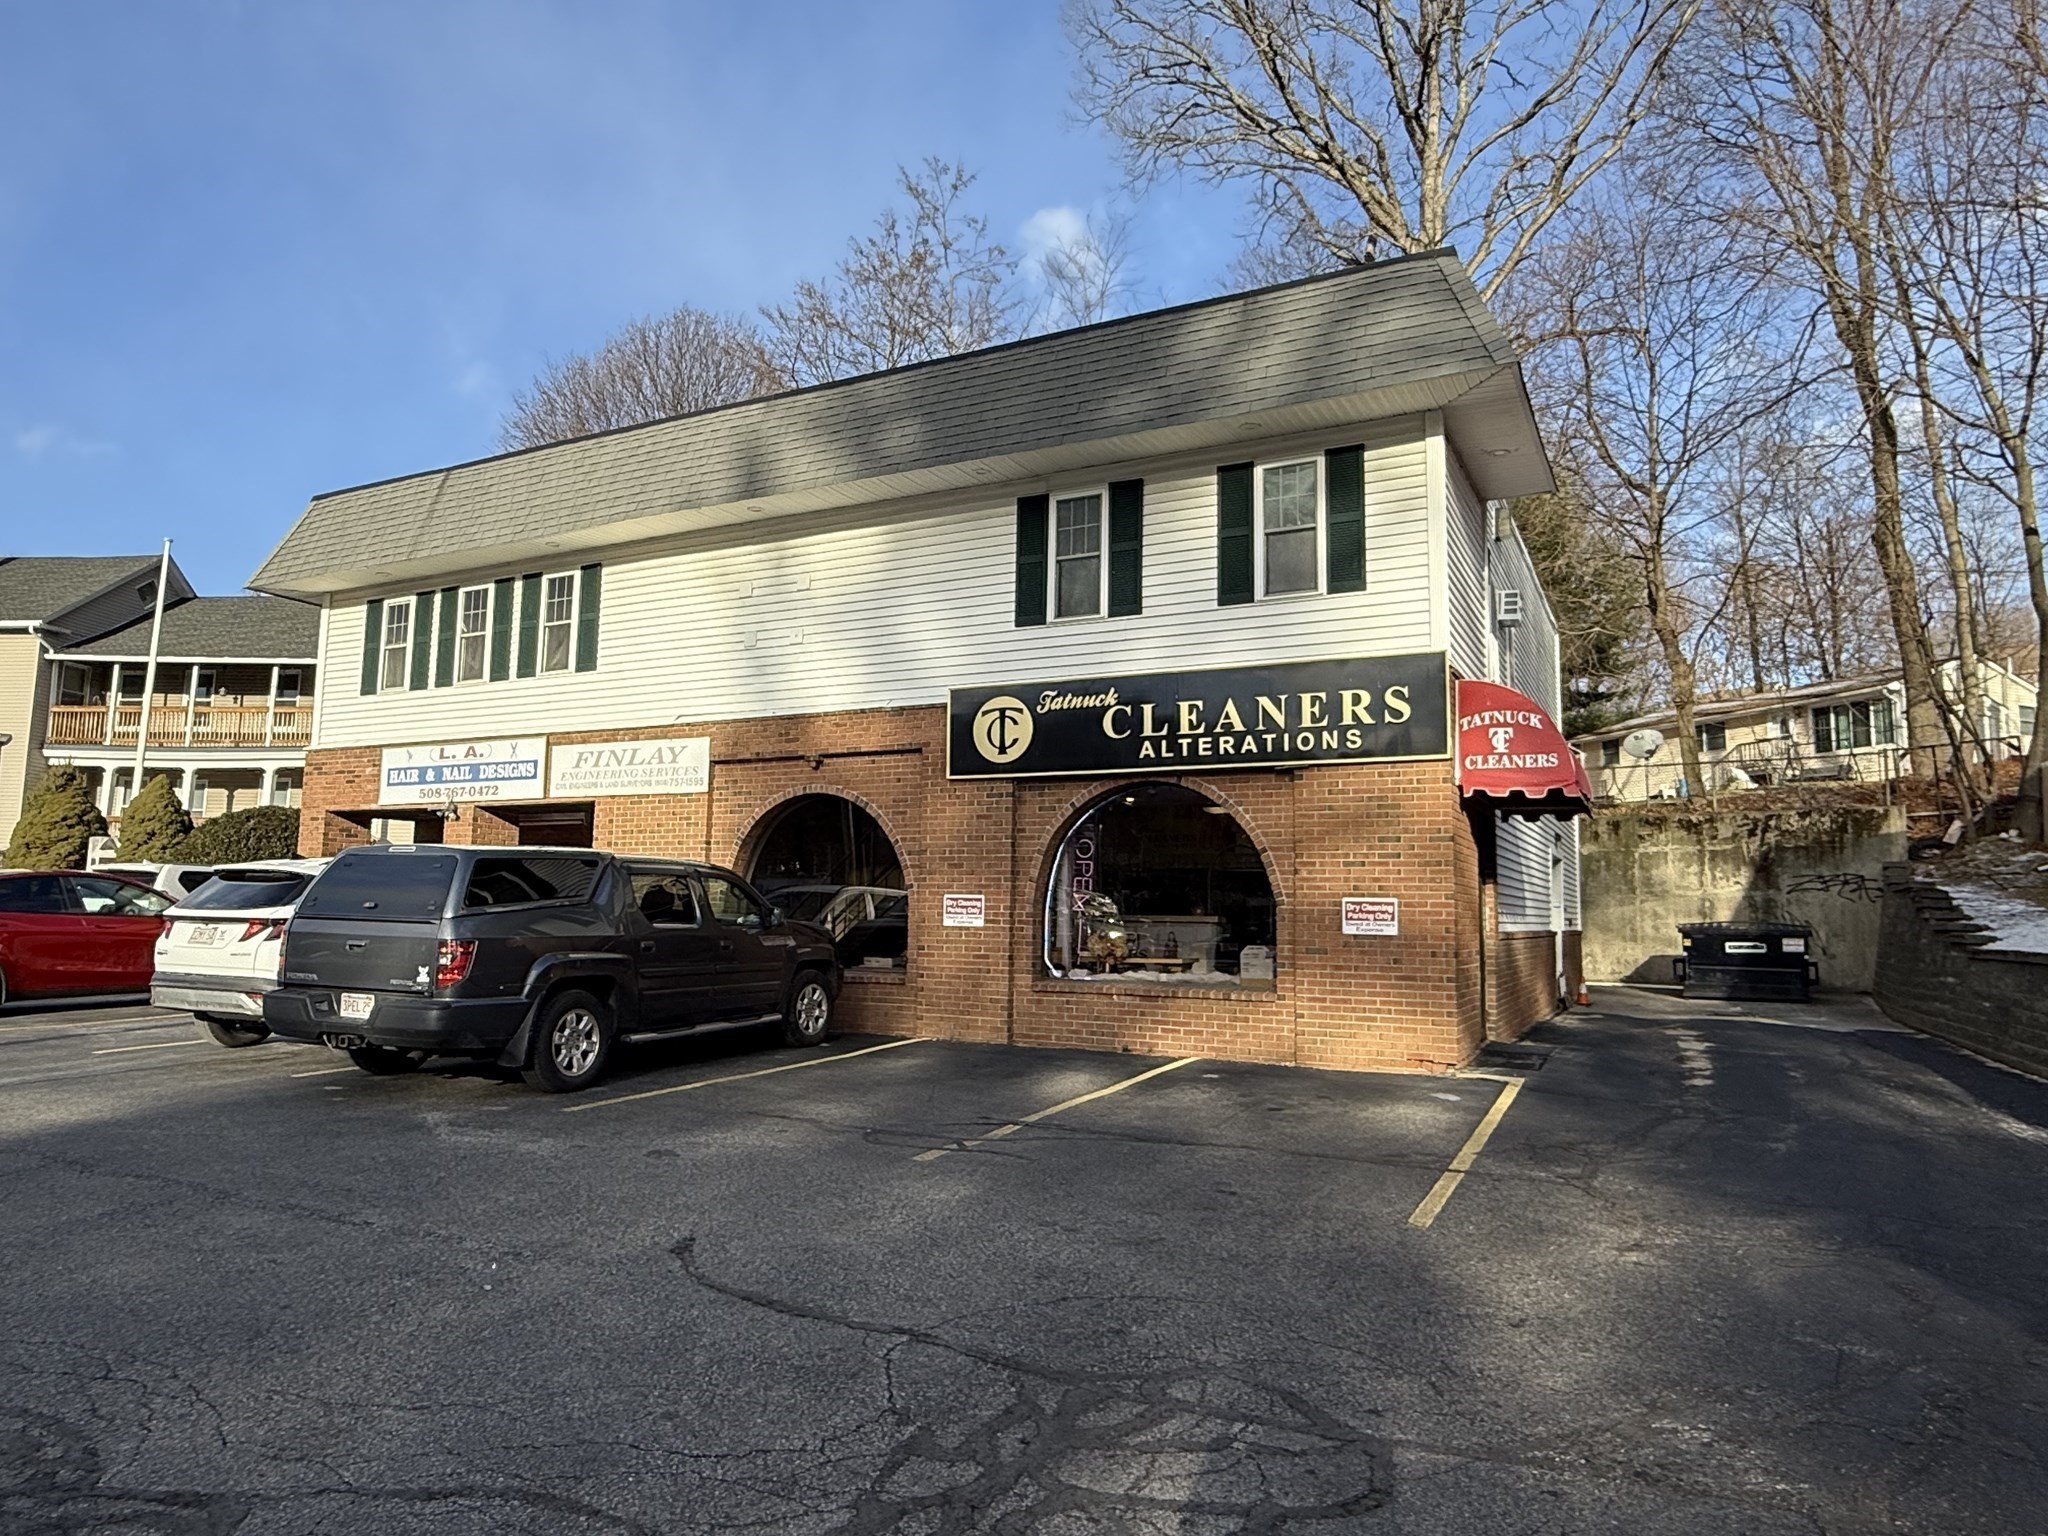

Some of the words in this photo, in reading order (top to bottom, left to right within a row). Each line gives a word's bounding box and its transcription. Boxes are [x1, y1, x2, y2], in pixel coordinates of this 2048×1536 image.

[1036, 686, 1119, 714] Tatnuck
[1102, 684, 1413, 739] CLEANERS
[1459, 710, 1543, 732] TATNUCK
[1138, 729, 1363, 760] ALTERATIONS
[571, 745, 689, 769] FINLAY
[1464, 753, 1559, 770] CLEANERS
[388, 767, 419, 784] HAIR
[425, 768, 435, 782] &
[442, 766, 473, 781] NAIL
[479, 762, 536, 779] DESIGNS
[560, 768, 638, 782] ENGINEERING
[640, 765, 700, 778] SERVICES
[418, 785, 499, 799] 508-767-0472
[1072, 838, 1094, 911] OPEN
[1346, 903, 1360, 912] Dry
[1375, 912, 1392, 921] Only
